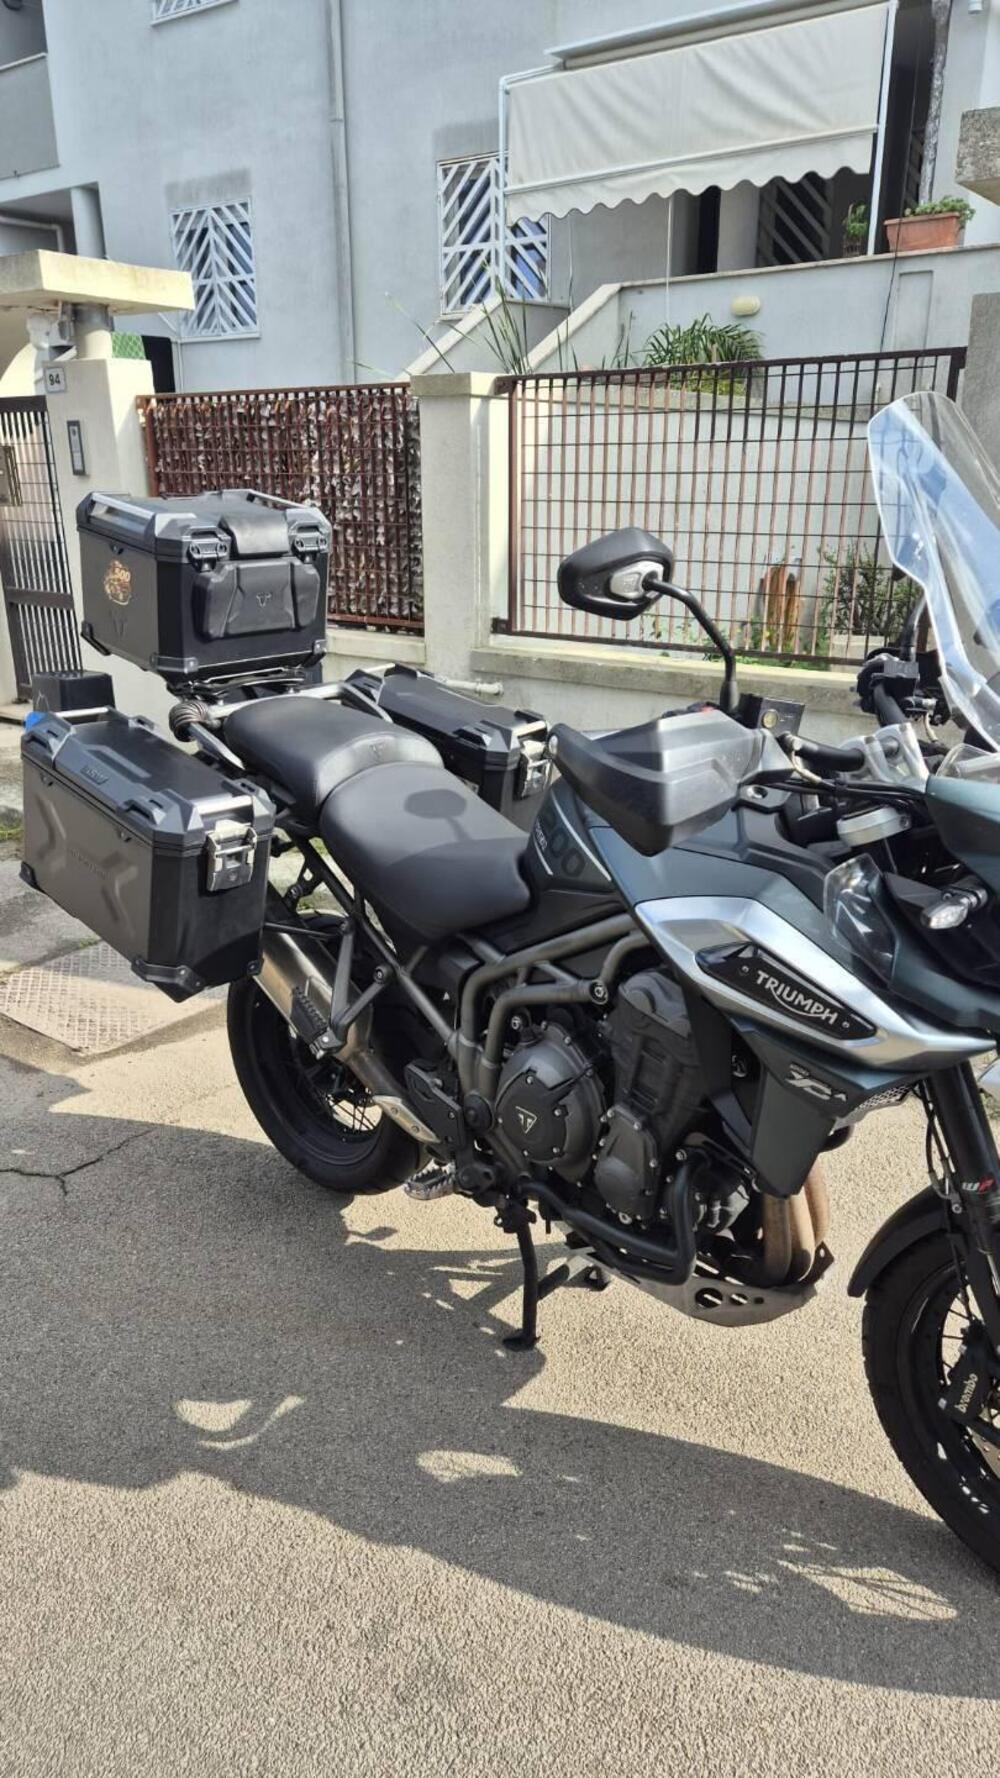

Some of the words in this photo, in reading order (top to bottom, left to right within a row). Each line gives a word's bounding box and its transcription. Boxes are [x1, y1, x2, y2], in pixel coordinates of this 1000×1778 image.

[48, 373, 61, 386] 94
[756, 970, 838, 1025] TRIUMPH
[954, 1373, 978, 1414] brembo
